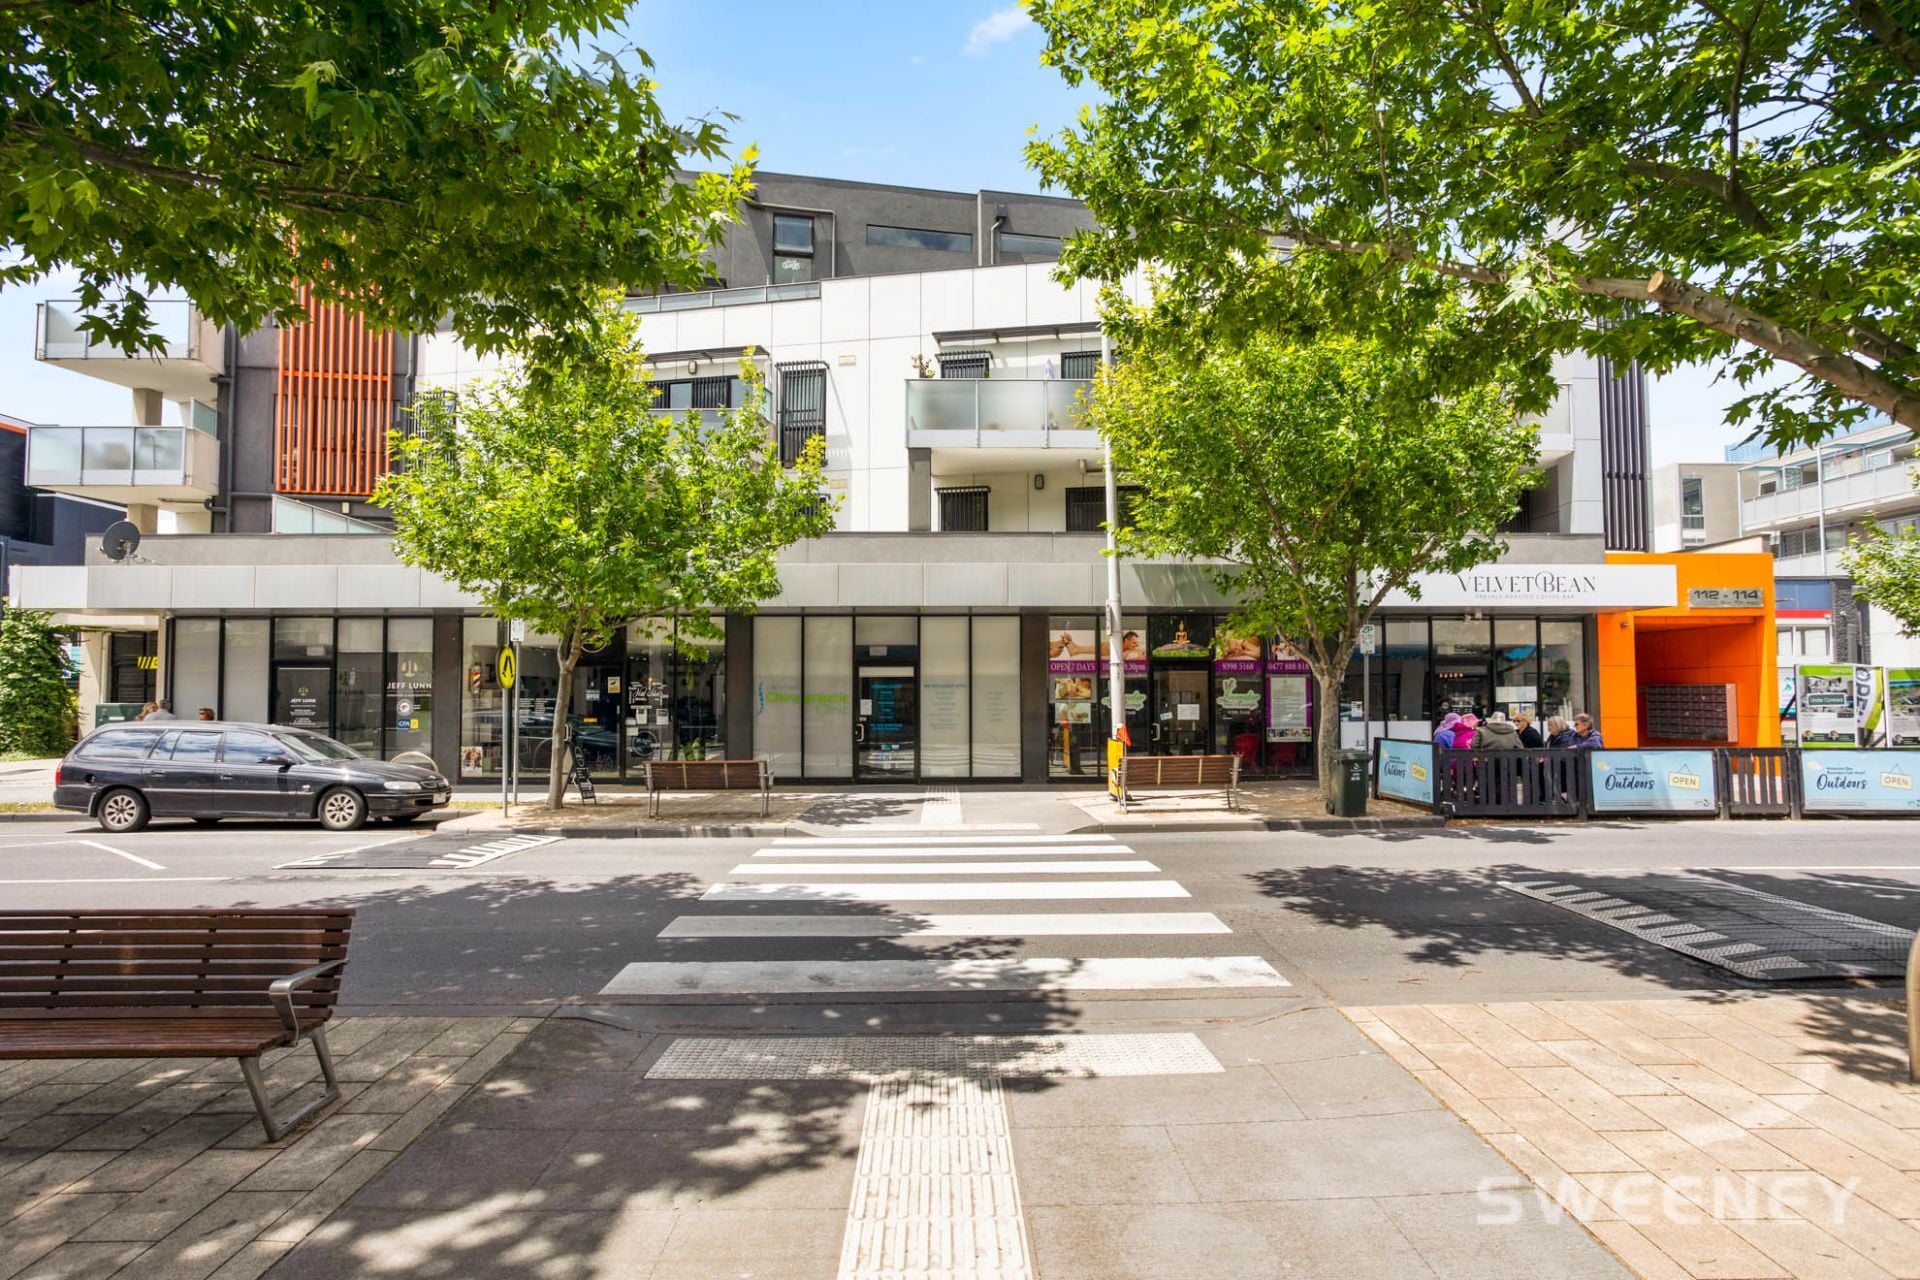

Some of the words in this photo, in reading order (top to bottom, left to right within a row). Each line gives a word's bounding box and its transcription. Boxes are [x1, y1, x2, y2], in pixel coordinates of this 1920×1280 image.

[1694, 590, 1719, 599] 112
[1732, 590, 1758, 599] 114
[1050, 663, 1069, 671] OPEN
[1071, 663, 1075, 671] 7
[1076, 663, 1096, 671] DAYS
[1605, 774, 1655, 791] Outdoors
[1672, 776, 1697, 787] OPEN
[1816, 773, 1867, 790] Outdoors
[1884, 775, 1909, 786] OPEN
